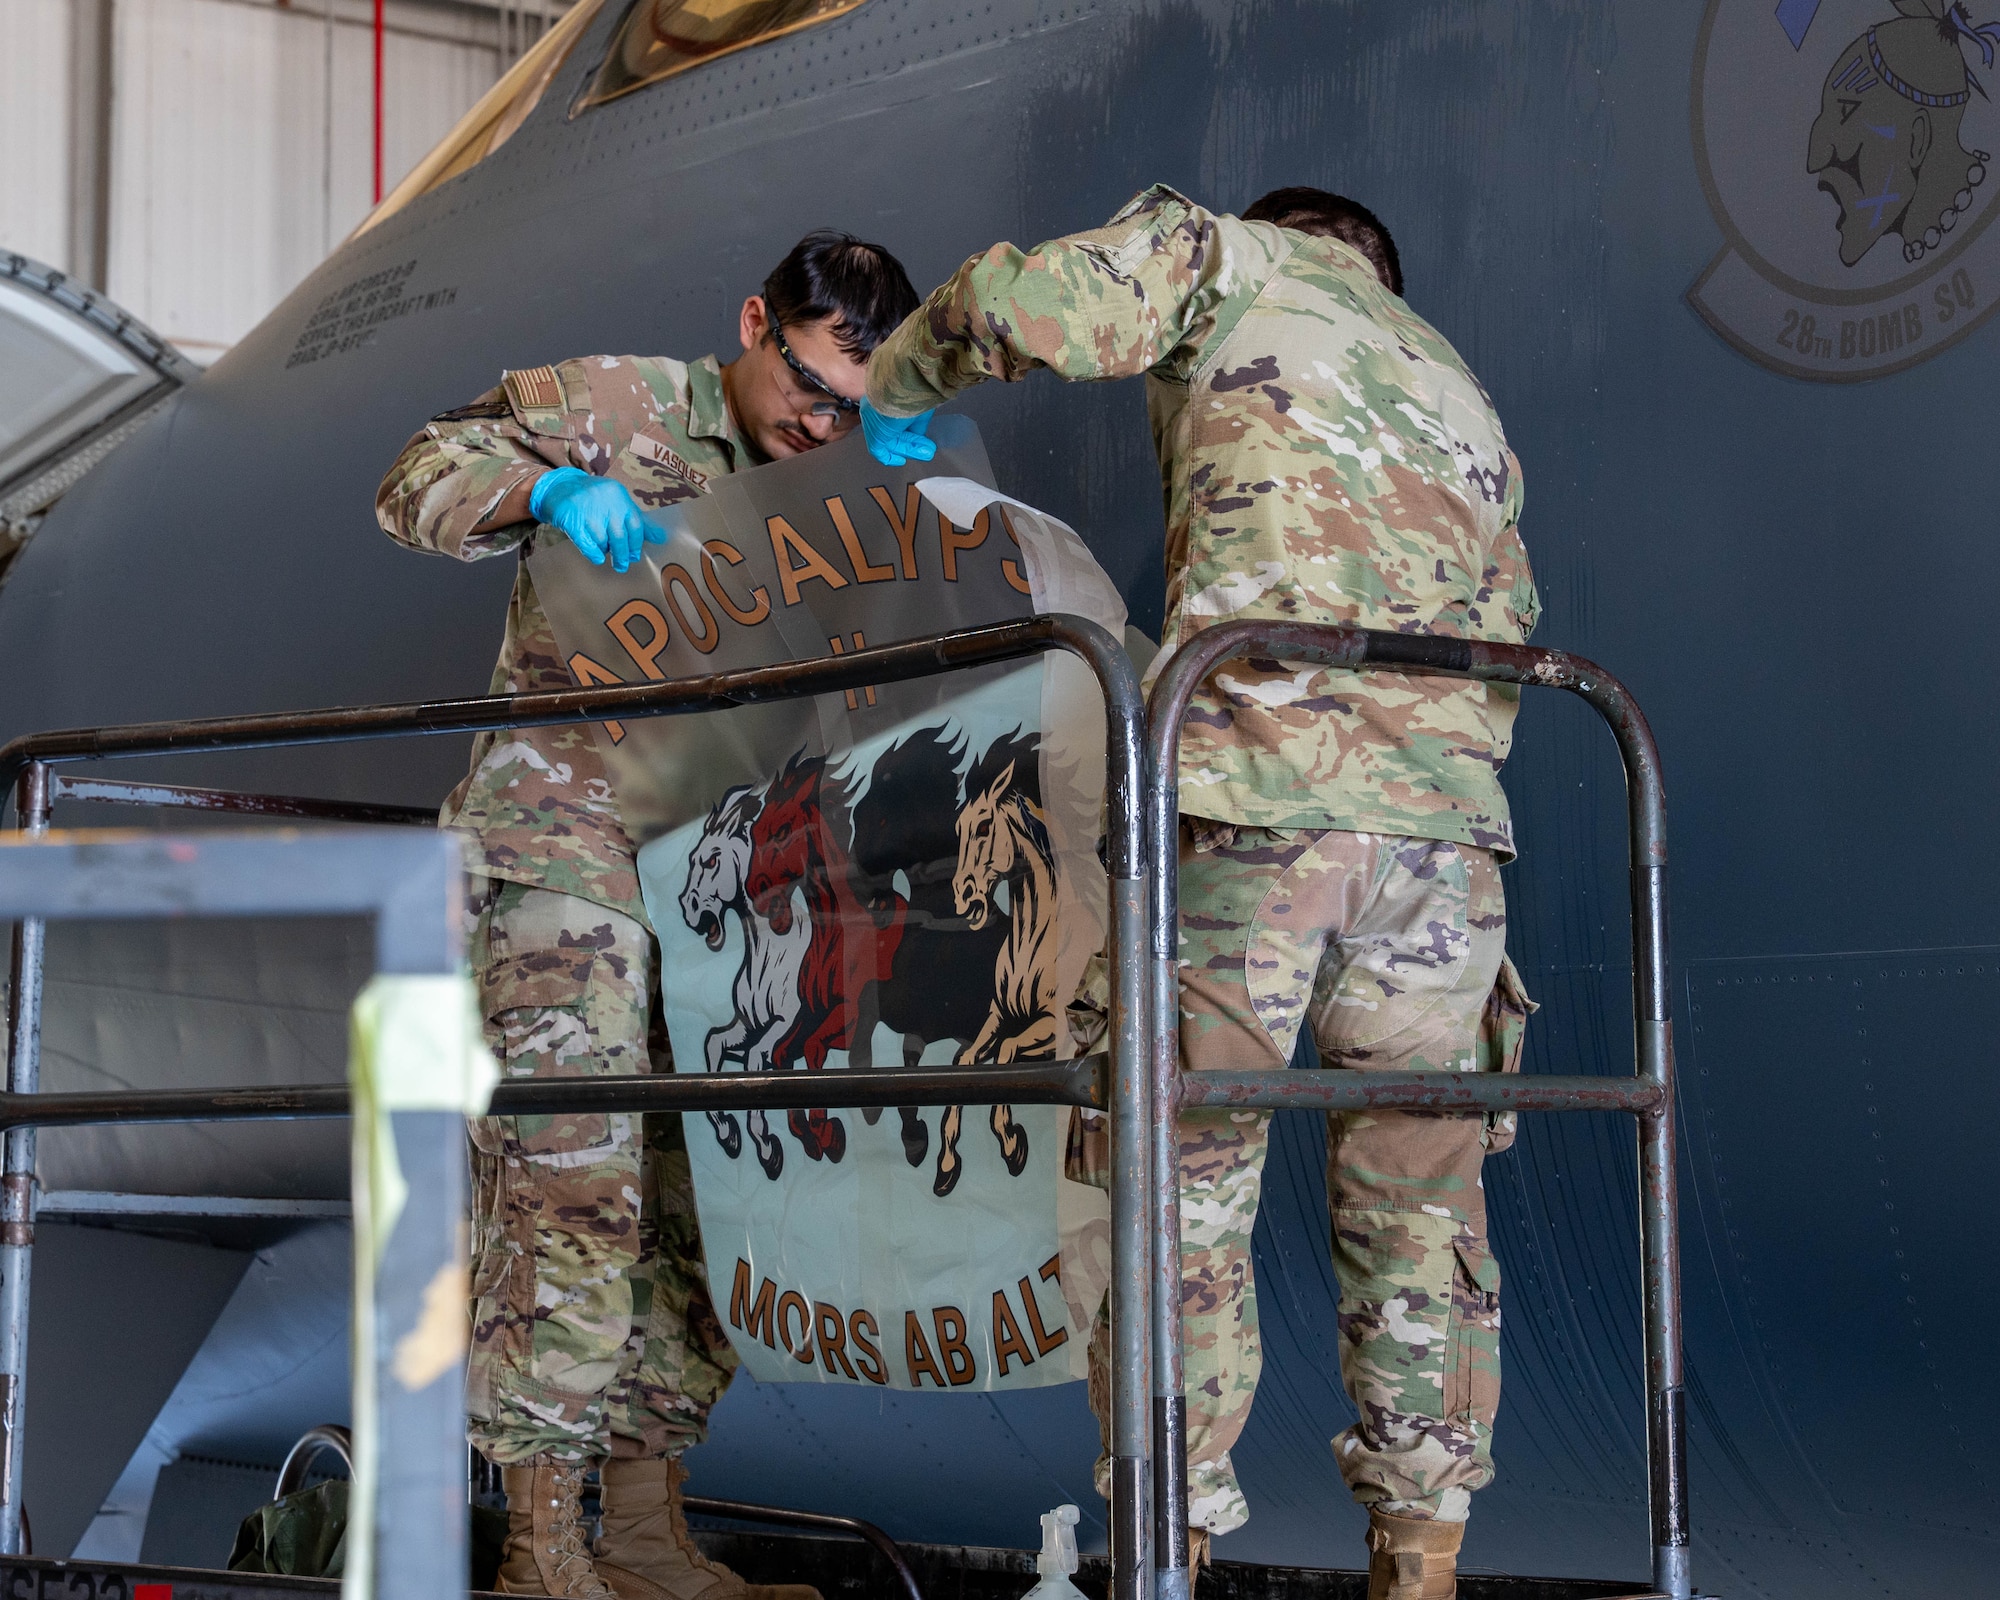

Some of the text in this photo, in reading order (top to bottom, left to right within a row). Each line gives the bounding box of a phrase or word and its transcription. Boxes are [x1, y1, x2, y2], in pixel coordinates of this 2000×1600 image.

[423, 286, 459, 311] WITH
[1839, 302, 1923, 360] BOMB
[1933, 268, 1976, 323] SQ
[653, 443, 707, 490] VASQUEZ
[730, 1256, 890, 1385] MORS
[904, 1305, 976, 1388] AB
